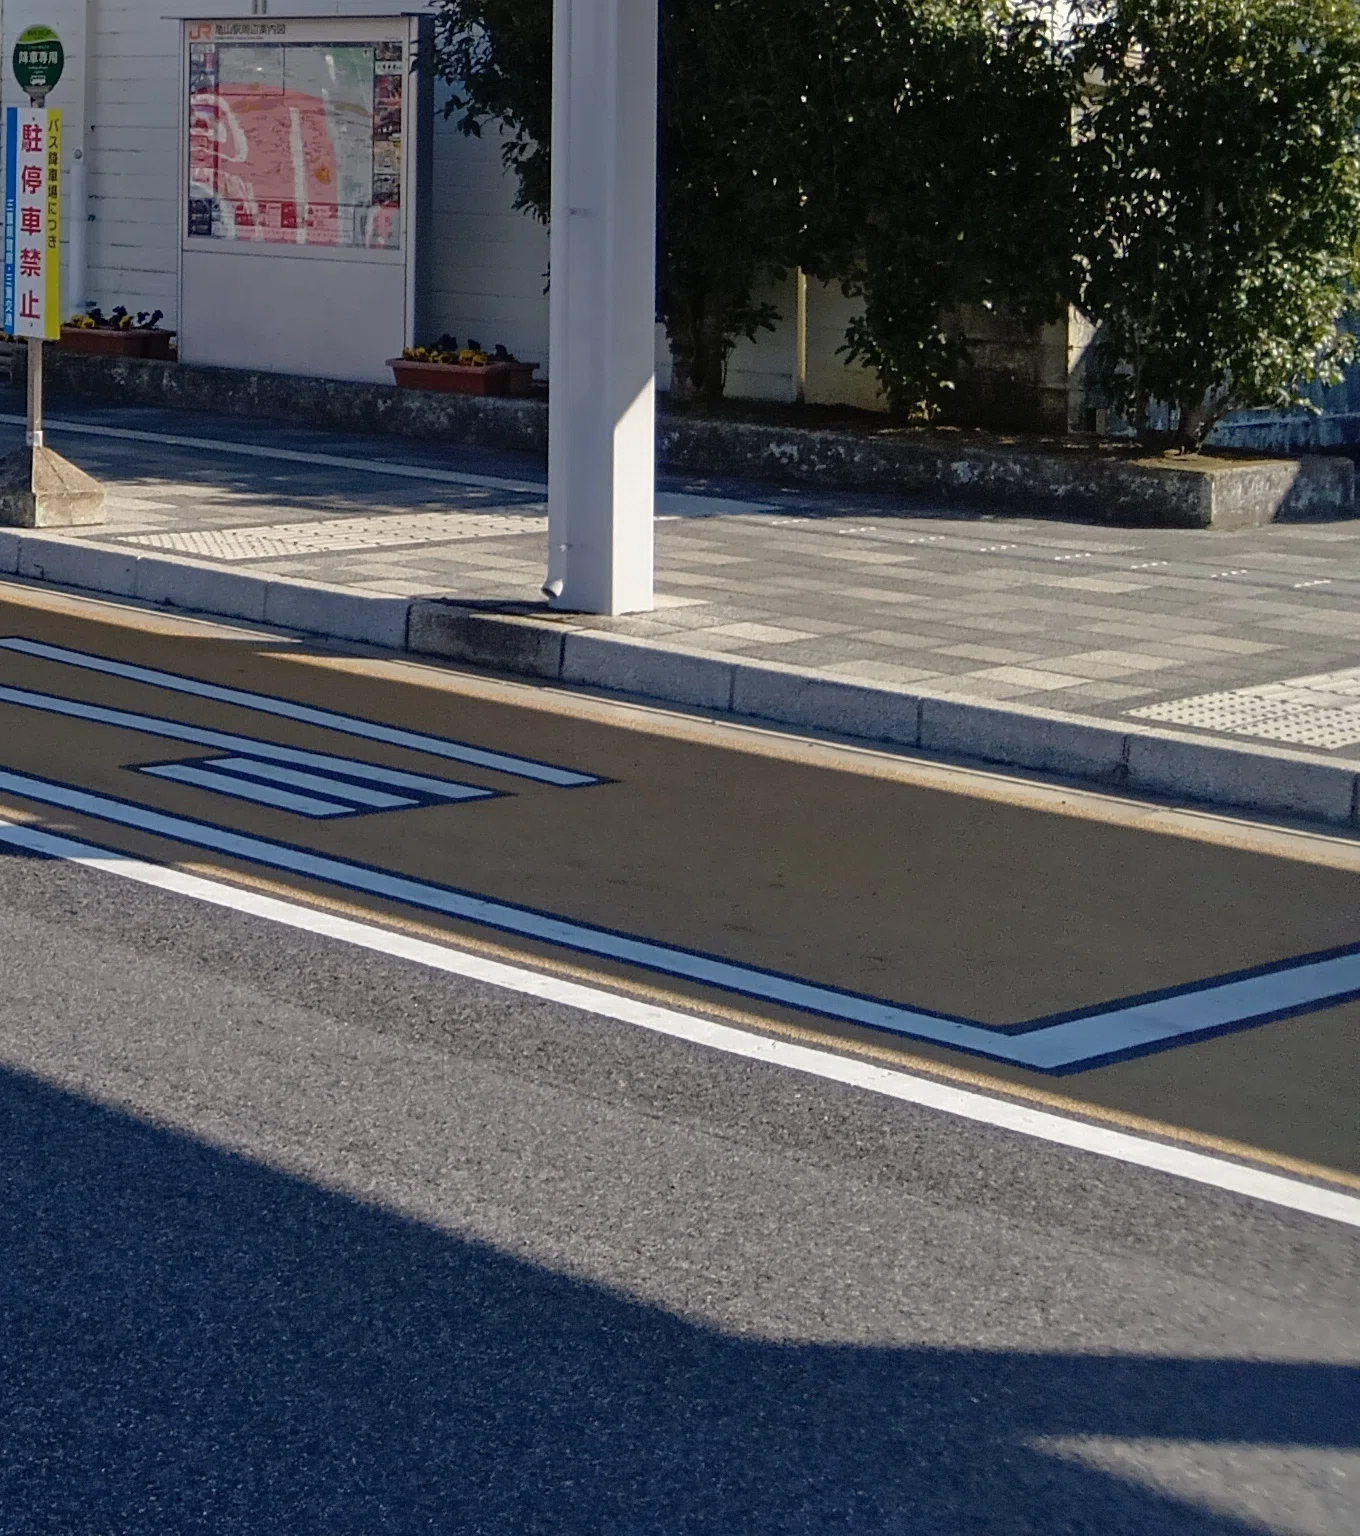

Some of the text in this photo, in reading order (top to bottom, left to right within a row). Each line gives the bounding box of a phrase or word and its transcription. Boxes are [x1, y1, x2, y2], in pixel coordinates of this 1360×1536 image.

[18, 51, 58, 64] 降車専用
[189, 24, 212, 40] JR
[47, 118, 60, 248] バス降車場につき
[20, 124, 42, 319] 駐停車禁止
